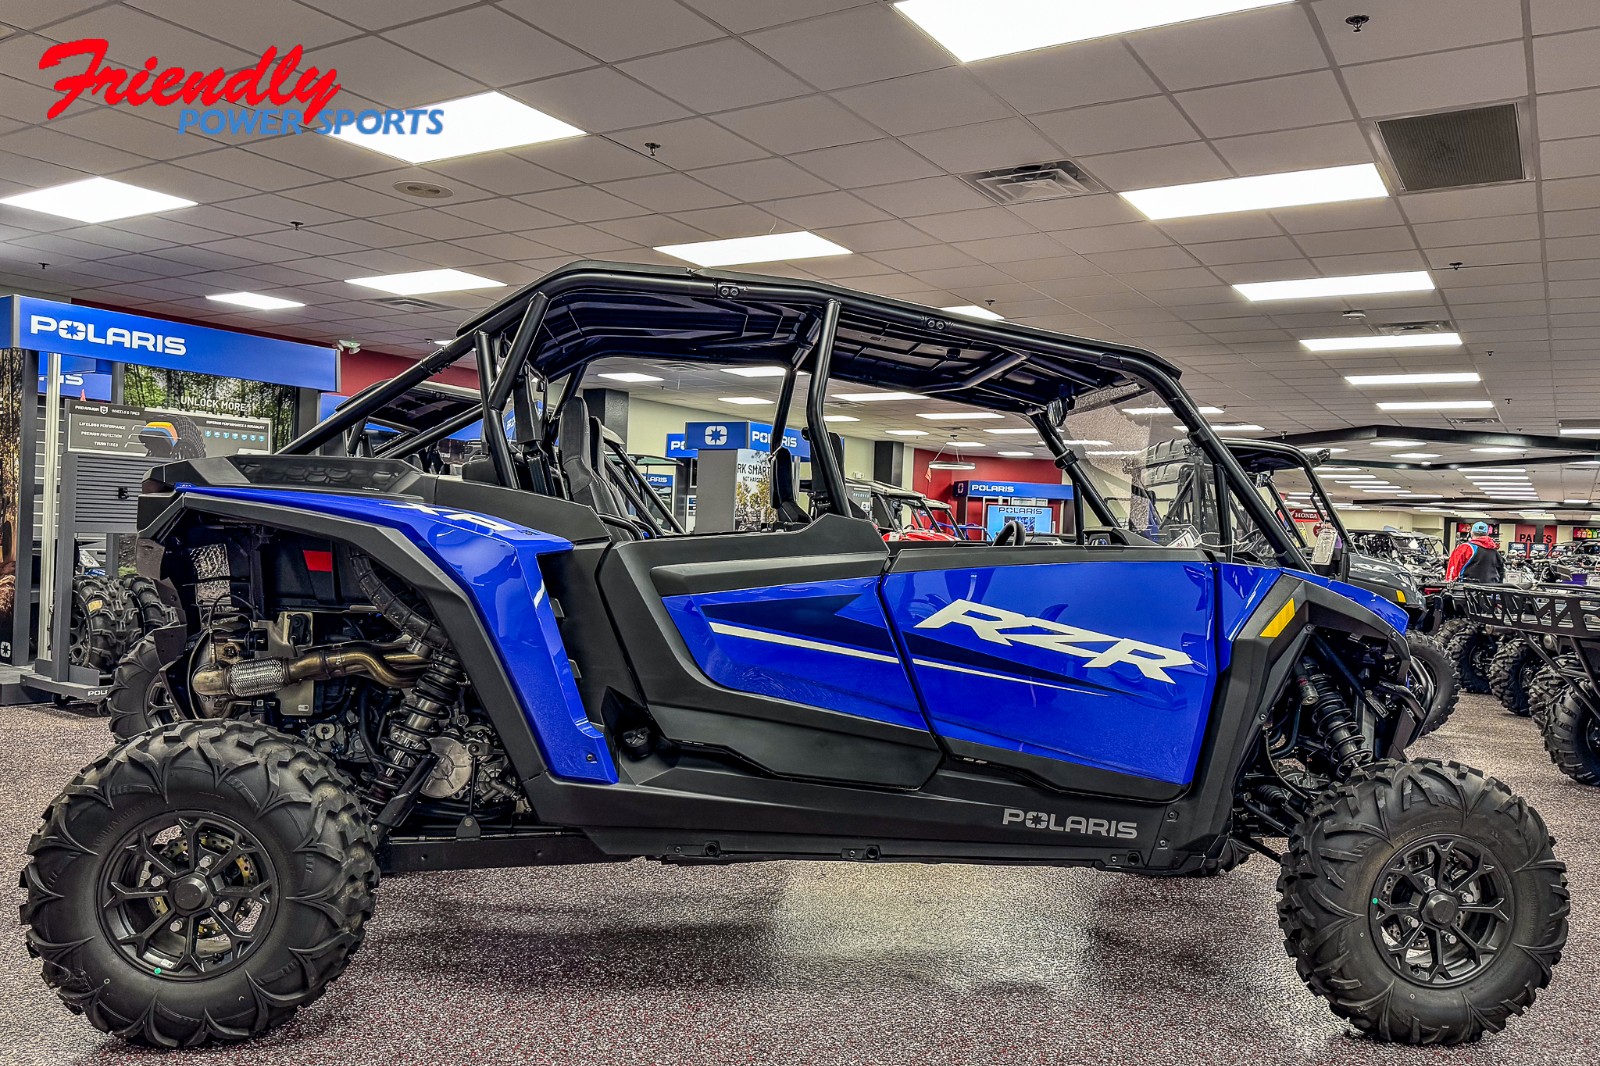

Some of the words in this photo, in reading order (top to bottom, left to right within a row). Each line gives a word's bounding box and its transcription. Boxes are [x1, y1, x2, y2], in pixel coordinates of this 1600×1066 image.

[30, 314, 187, 356] POLARIS
[180, 395, 219, 409] UNLOCK
[752, 431, 797, 447] POLRIS
[971, 484, 1015, 493] POLARIS
[998, 507, 1043, 515] POLARIS
[913, 598, 1193, 684] RZR
[1002, 807, 1138, 839] POLARIS
